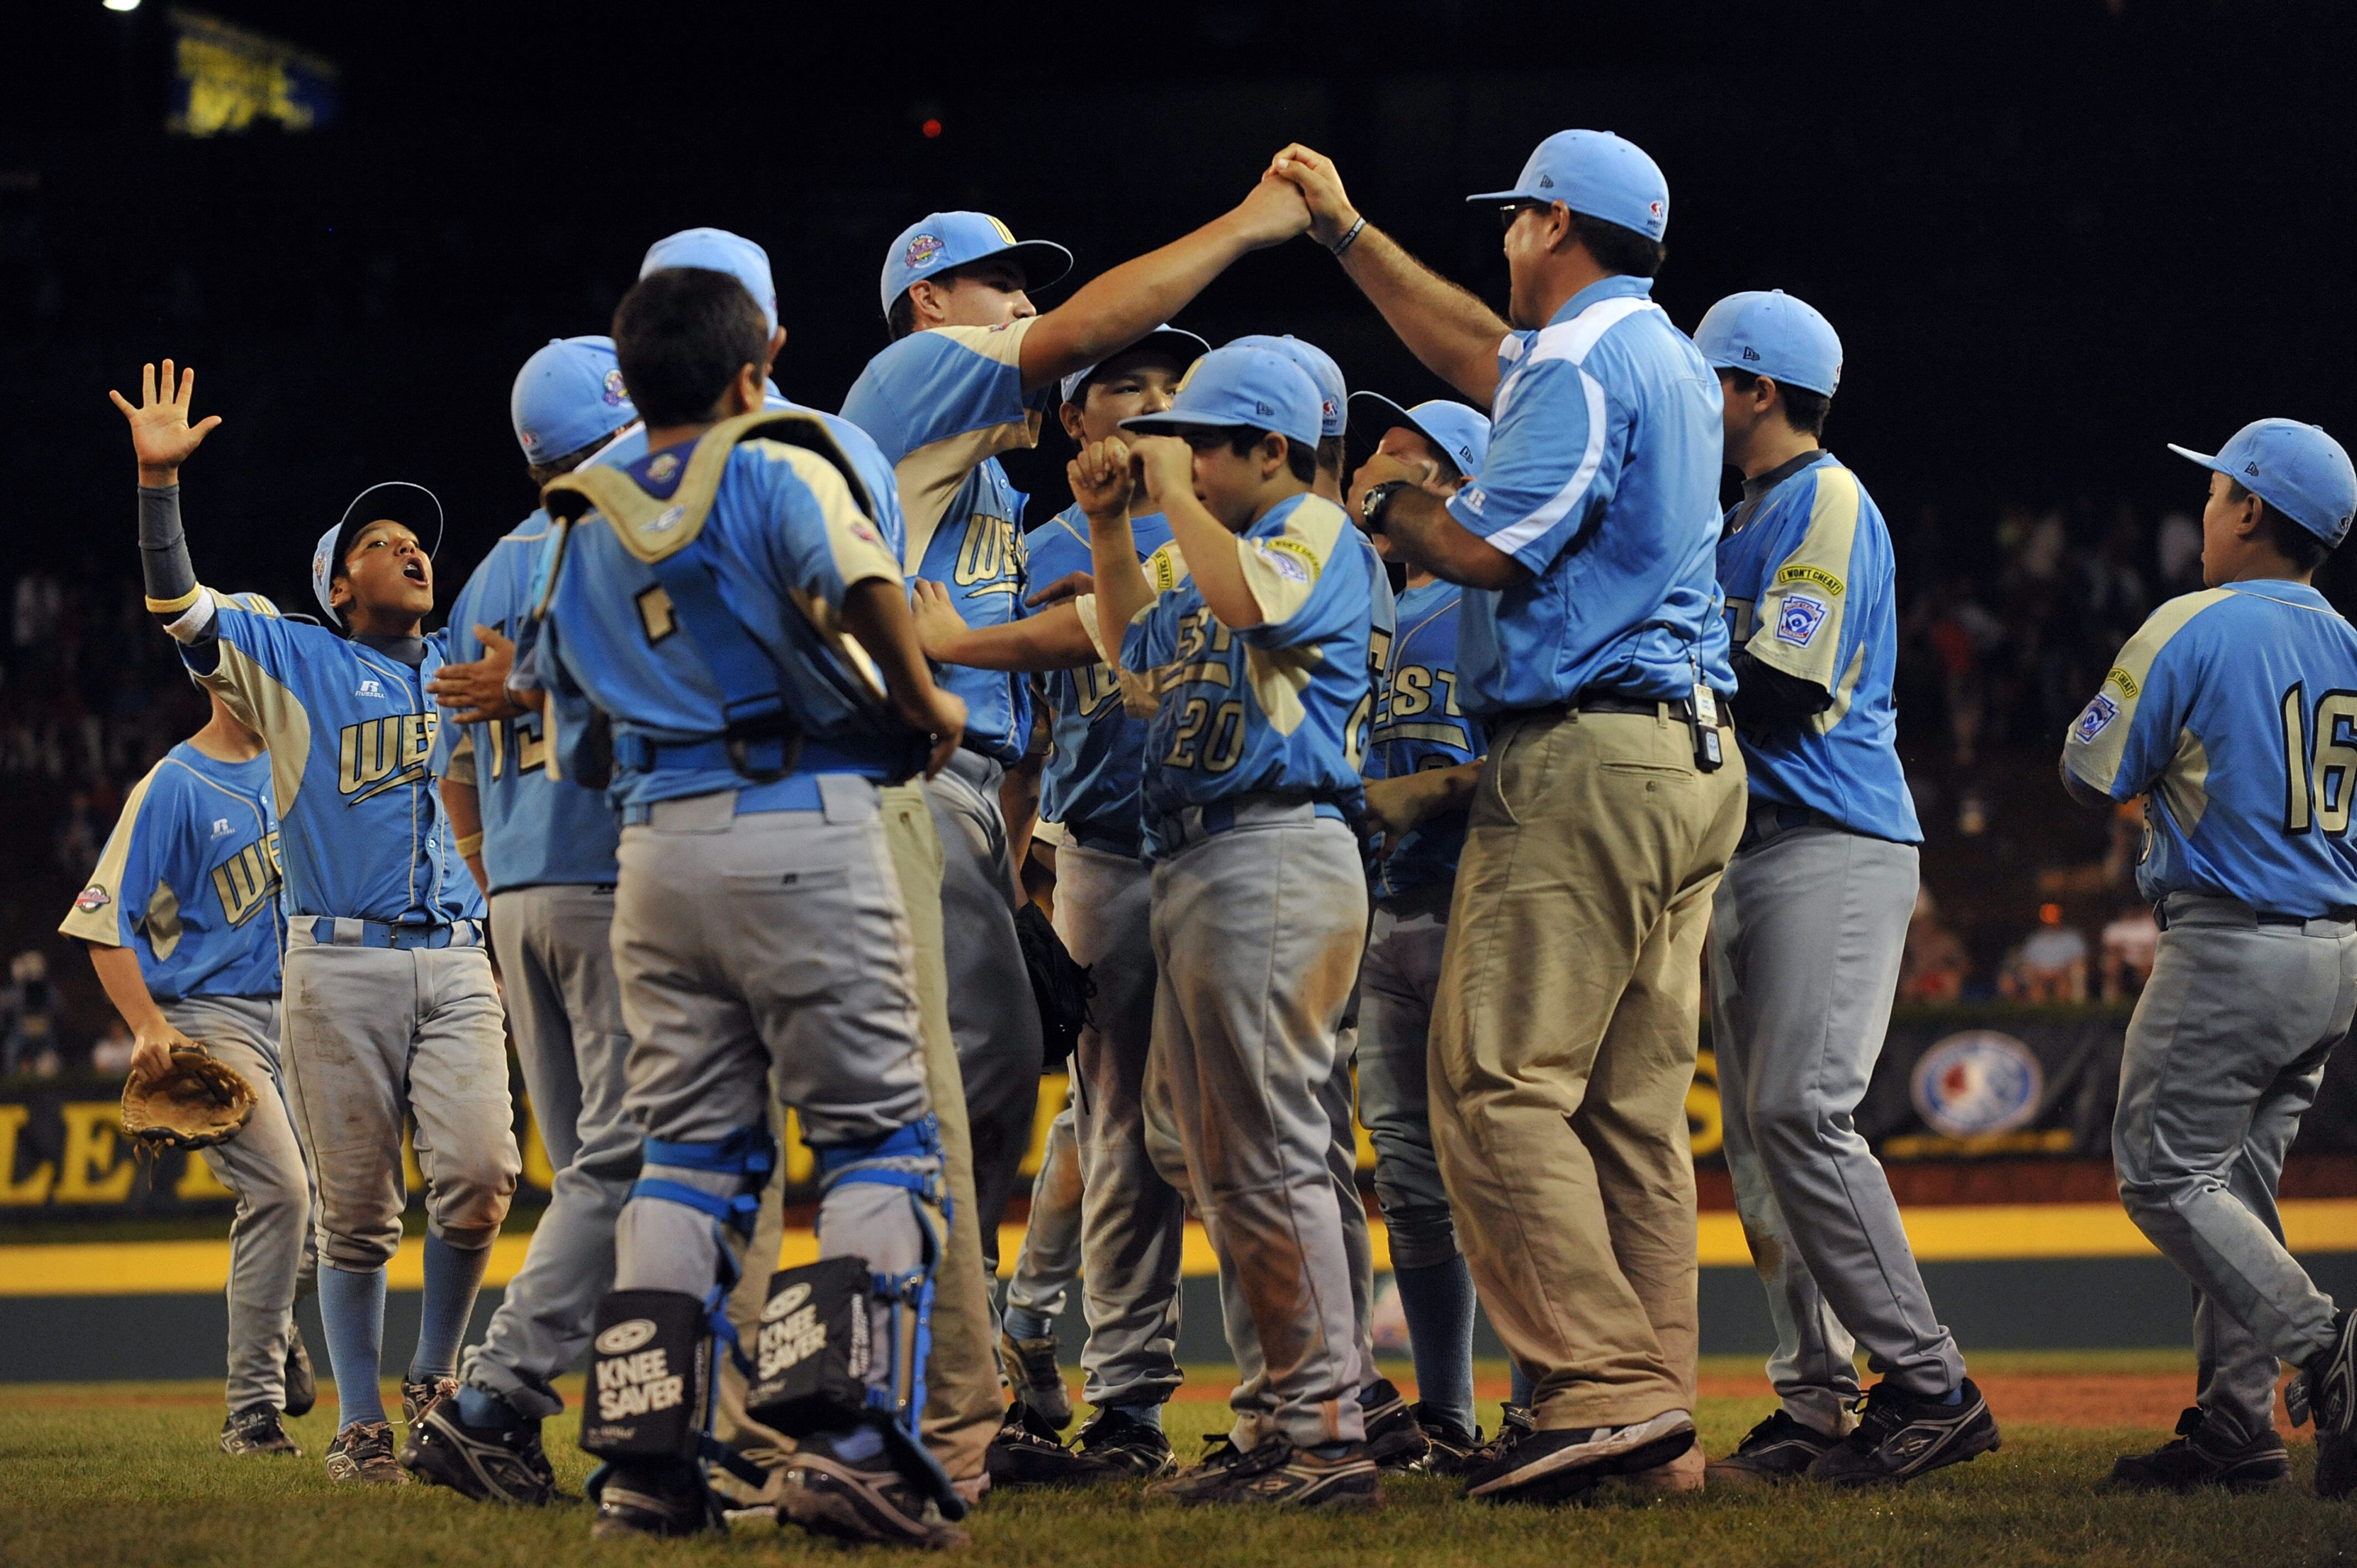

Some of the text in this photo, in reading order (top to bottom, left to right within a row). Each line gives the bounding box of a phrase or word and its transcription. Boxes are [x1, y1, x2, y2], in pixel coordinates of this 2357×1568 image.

[954, 513, 1029, 587] WE
[1787, 569, 1812, 578] WON'T
[1813, 571, 1840, 593] CHEAT!
[339, 713, 438, 795] WE
[1162, 696, 1244, 772] 20
[2280, 680, 2357, 838] 16
[210, 831, 282, 926] WE
[758, 1303, 817, 1356] KNEE
[758, 1322, 827, 1381] SAVER
[595, 1347, 669, 1391] KNEE
[598, 1375, 685, 1421] SAVER
